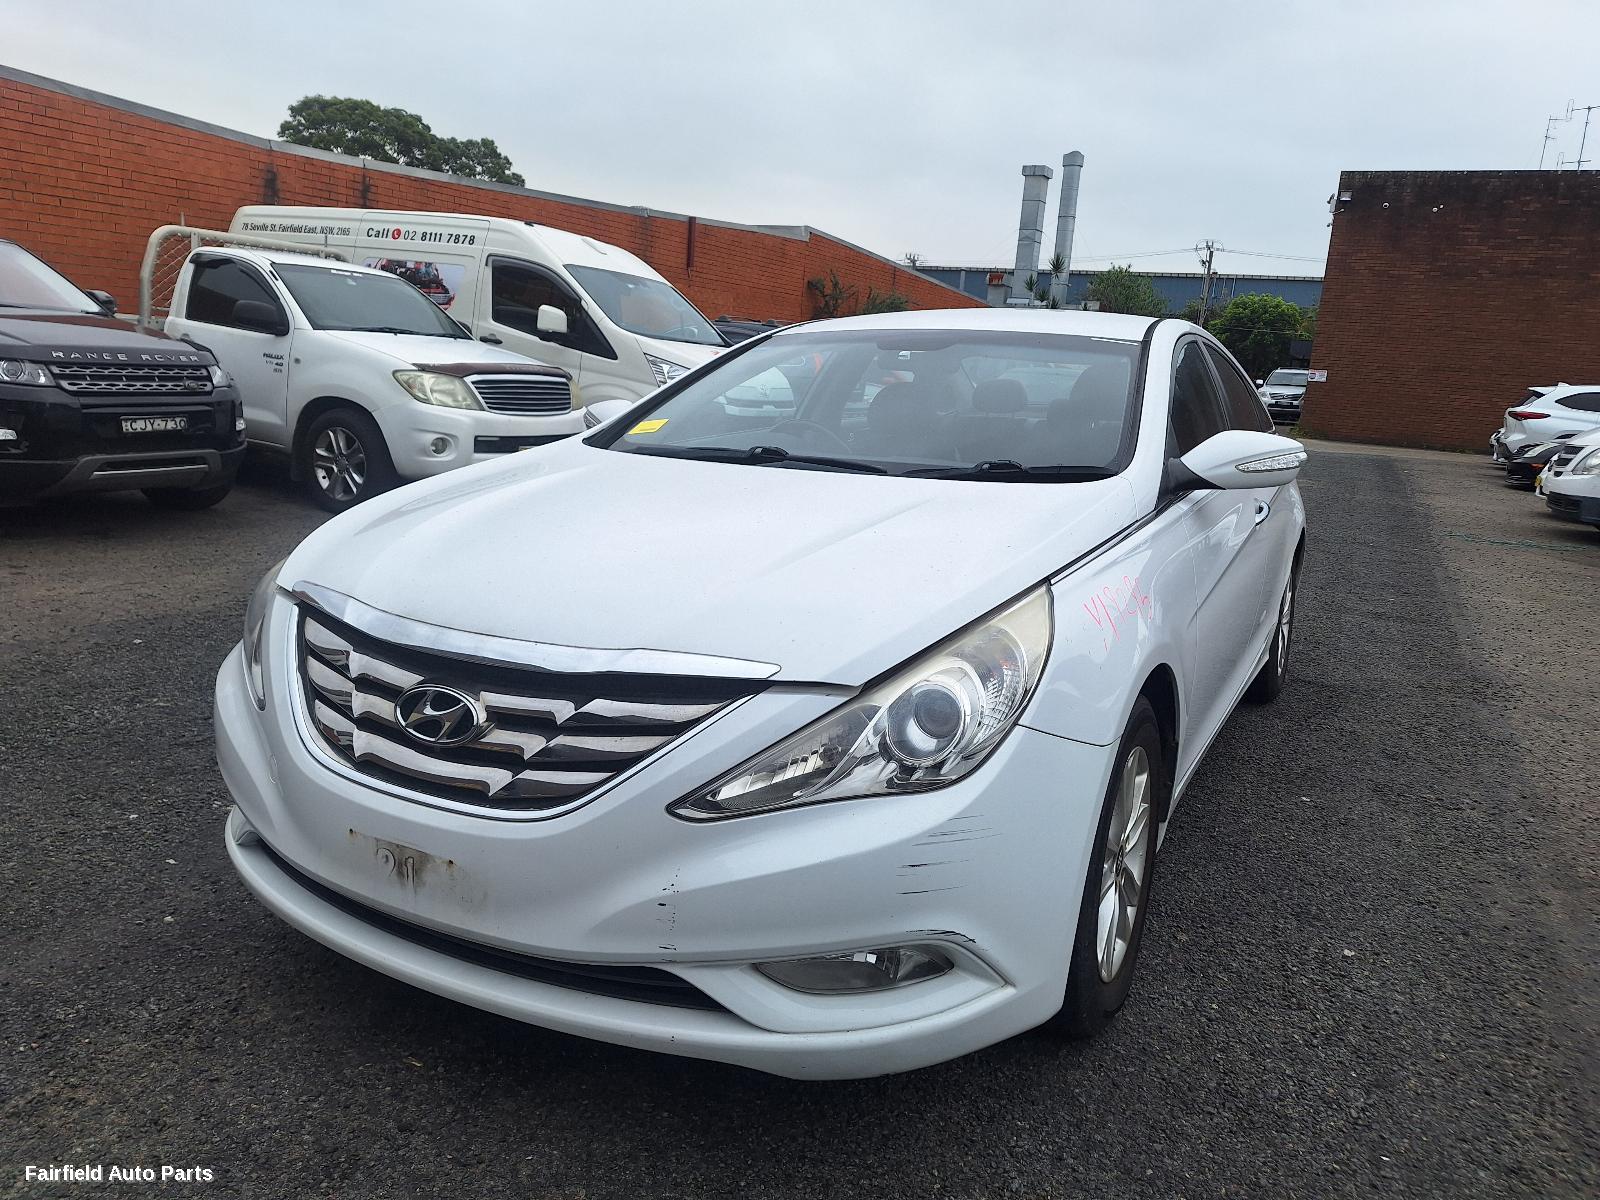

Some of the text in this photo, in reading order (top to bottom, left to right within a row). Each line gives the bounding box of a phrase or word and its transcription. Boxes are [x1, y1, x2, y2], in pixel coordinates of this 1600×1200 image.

[277, 223, 303, 234] Fairfield
[335, 227, 351, 237] 2165
[366, 227, 476, 245] Call 02 8111 7878
[51, 350, 200, 362] RANGE ROVER
